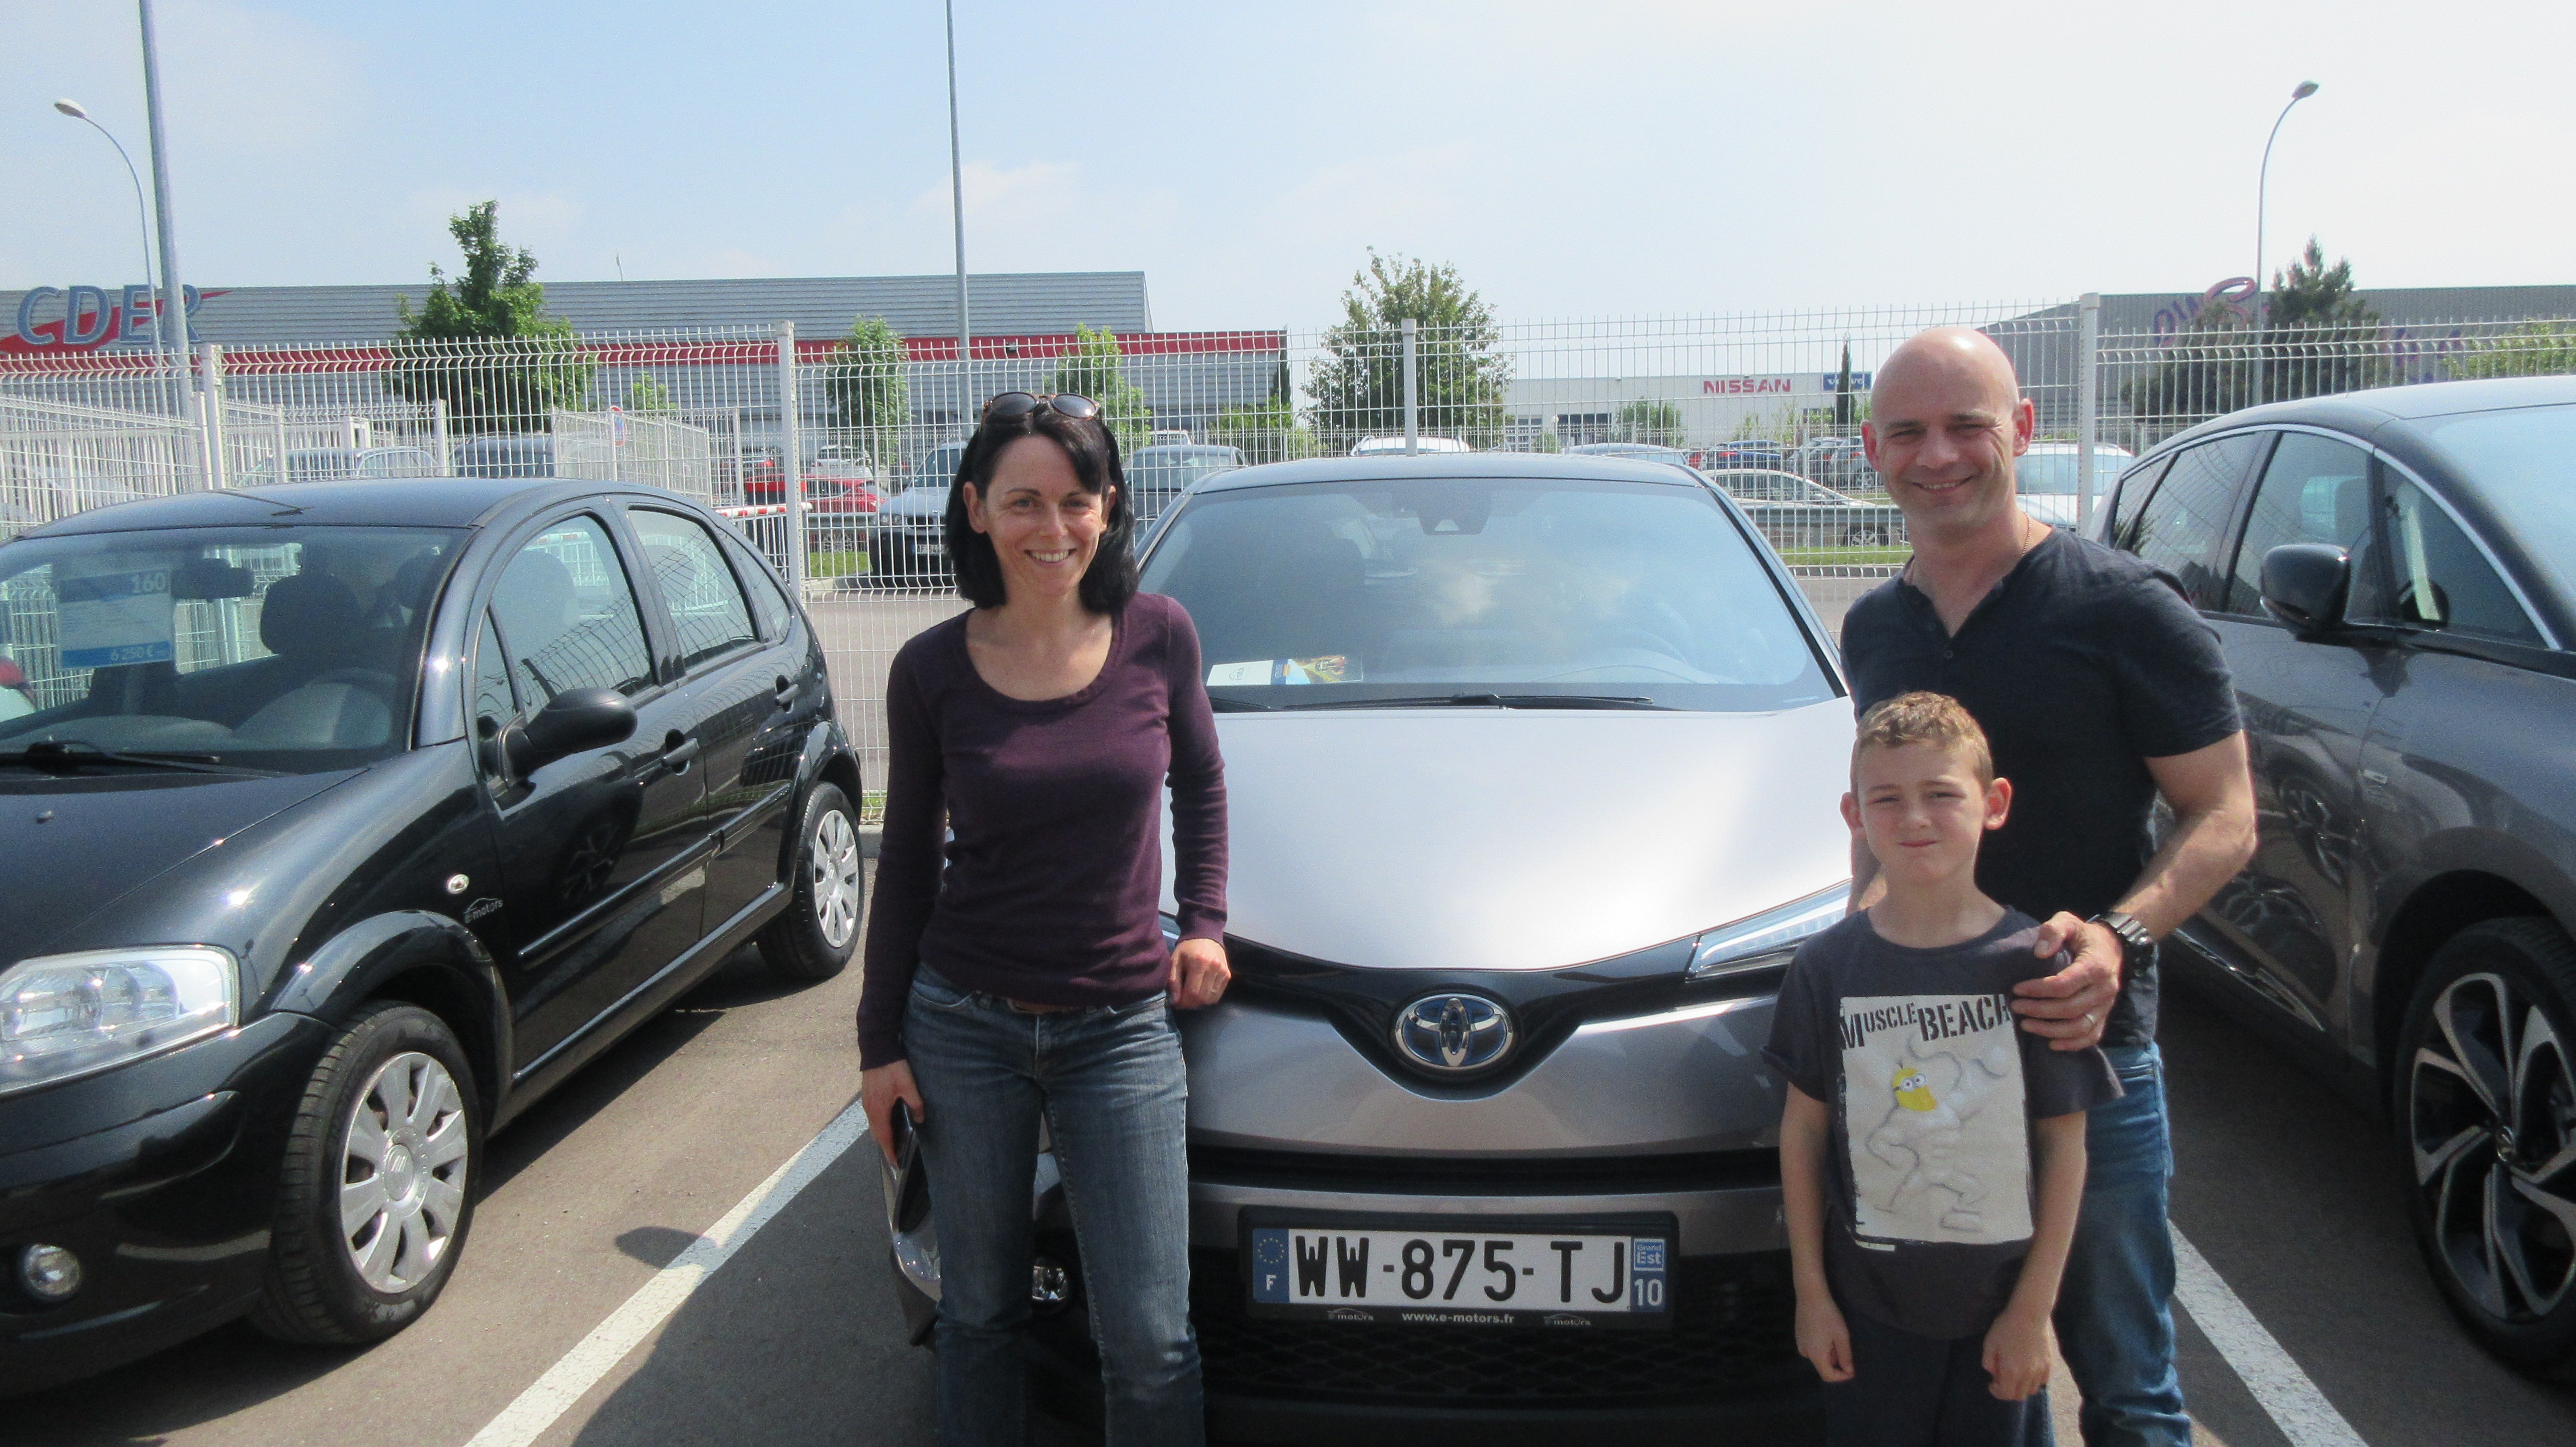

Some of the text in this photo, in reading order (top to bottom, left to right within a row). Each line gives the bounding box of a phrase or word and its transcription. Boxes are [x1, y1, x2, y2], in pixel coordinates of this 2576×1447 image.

[1703, 379, 1792, 394] NISSAN
[1839, 994, 2012, 1050] MUSCLE BEACH
[1637, 1251, 1661, 1265] Est
[1266, 1275, 1277, 1291] F
[1634, 1279, 1663, 1306] 10
[1402, 1313, 1515, 1324] www.e-motors.fr
